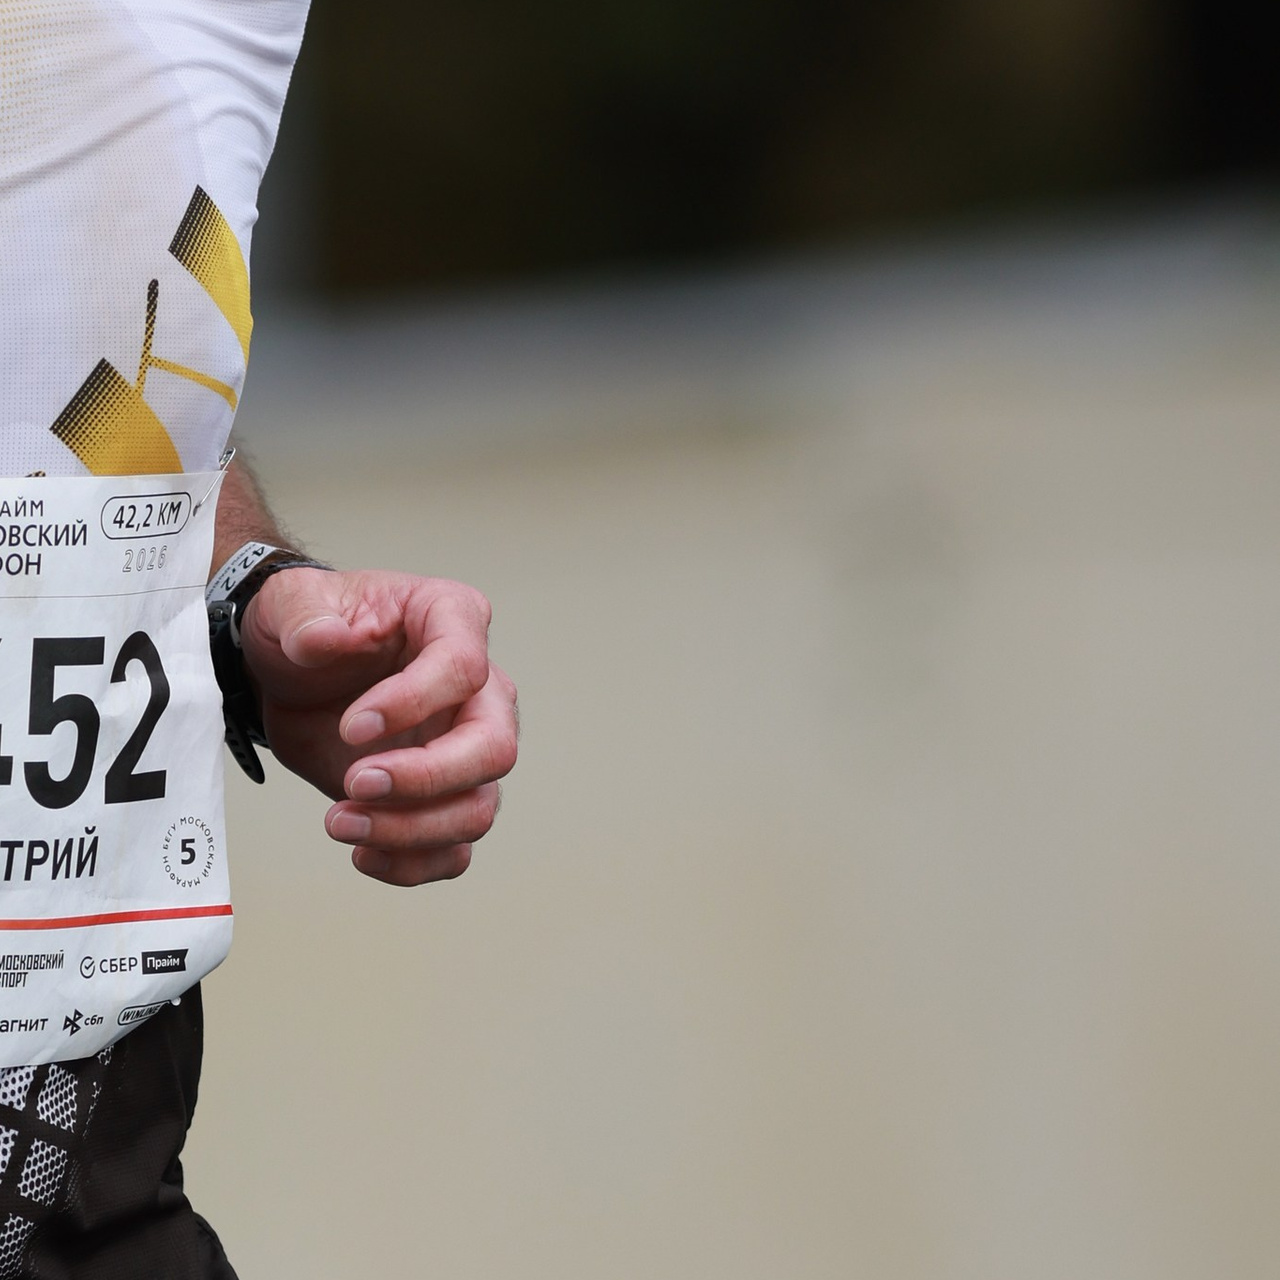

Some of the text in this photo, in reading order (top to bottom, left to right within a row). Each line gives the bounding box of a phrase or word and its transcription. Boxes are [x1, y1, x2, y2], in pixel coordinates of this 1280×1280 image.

[112, 500, 183, 532] 42,2 КМ
[163, 816, 214, 887] БЕГУ МОСКОВСКИЙ МАРАФОН
[181, 838, 196, 865] 5
[99, 955, 180, 973] СБЕР Прайм
[83, 1015, 104, 1026] сбп
